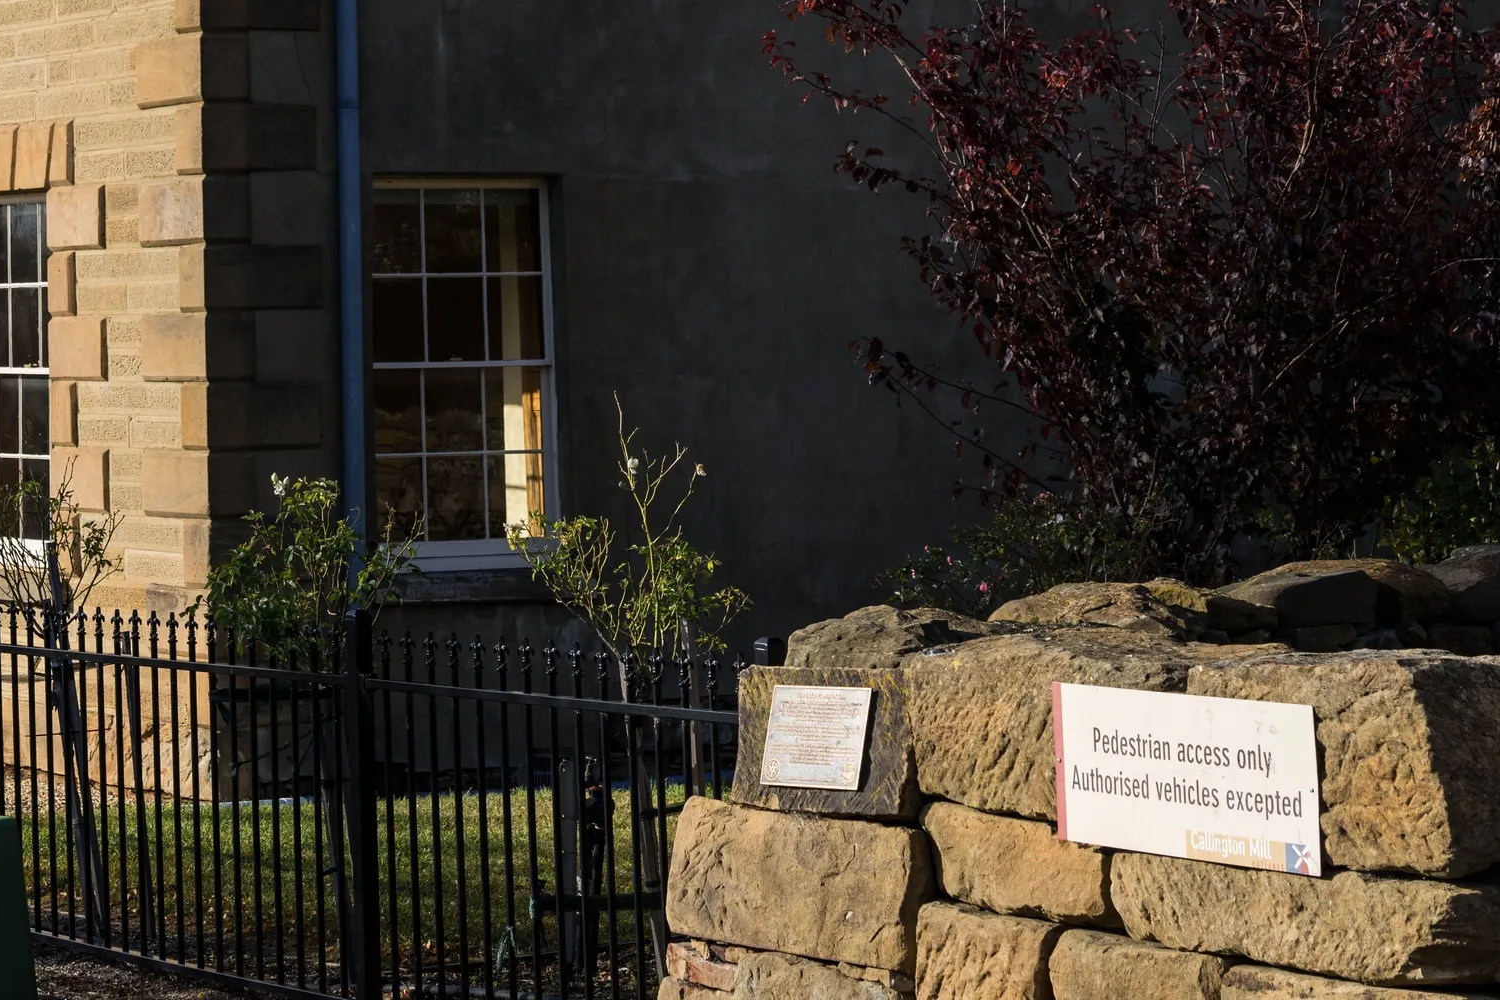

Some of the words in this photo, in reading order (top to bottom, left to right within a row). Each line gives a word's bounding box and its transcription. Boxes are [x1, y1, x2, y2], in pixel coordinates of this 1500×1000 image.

[1092, 726, 1171, 761] Pedestrian
[1177, 742, 1231, 768] access
[1236, 743, 1272, 779] only
[1072, 764, 1150, 800] Authorised
[1155, 776, 1220, 809] vehicles
[1226, 790, 1303, 821] excepted
[1190, 830, 1246, 859] Callington
[1249, 837, 1272, 860] Mill
[1251, 860, 1285, 872] OATLANDS
